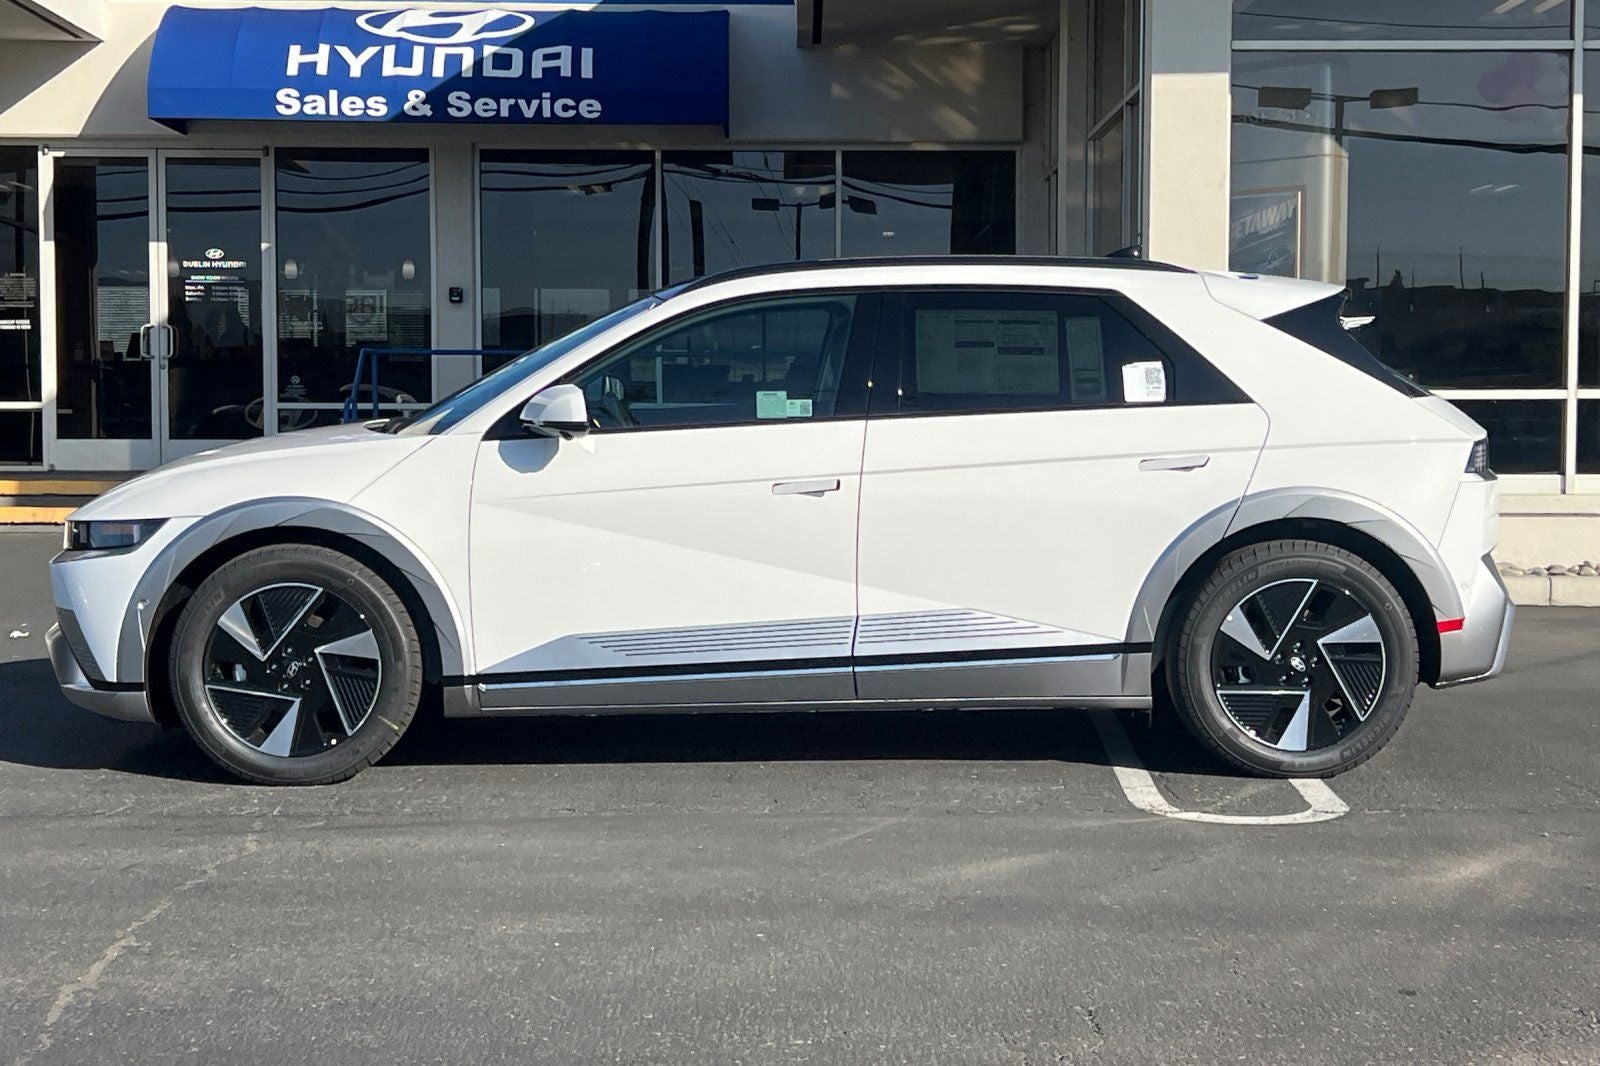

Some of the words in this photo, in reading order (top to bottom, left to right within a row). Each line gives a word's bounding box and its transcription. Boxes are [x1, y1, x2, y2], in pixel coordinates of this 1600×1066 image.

[285, 43, 594, 79] HYUNDAI
[275, 87, 388, 117] Sales
[403, 88, 434, 118] &
[446, 90, 602, 119] Service
